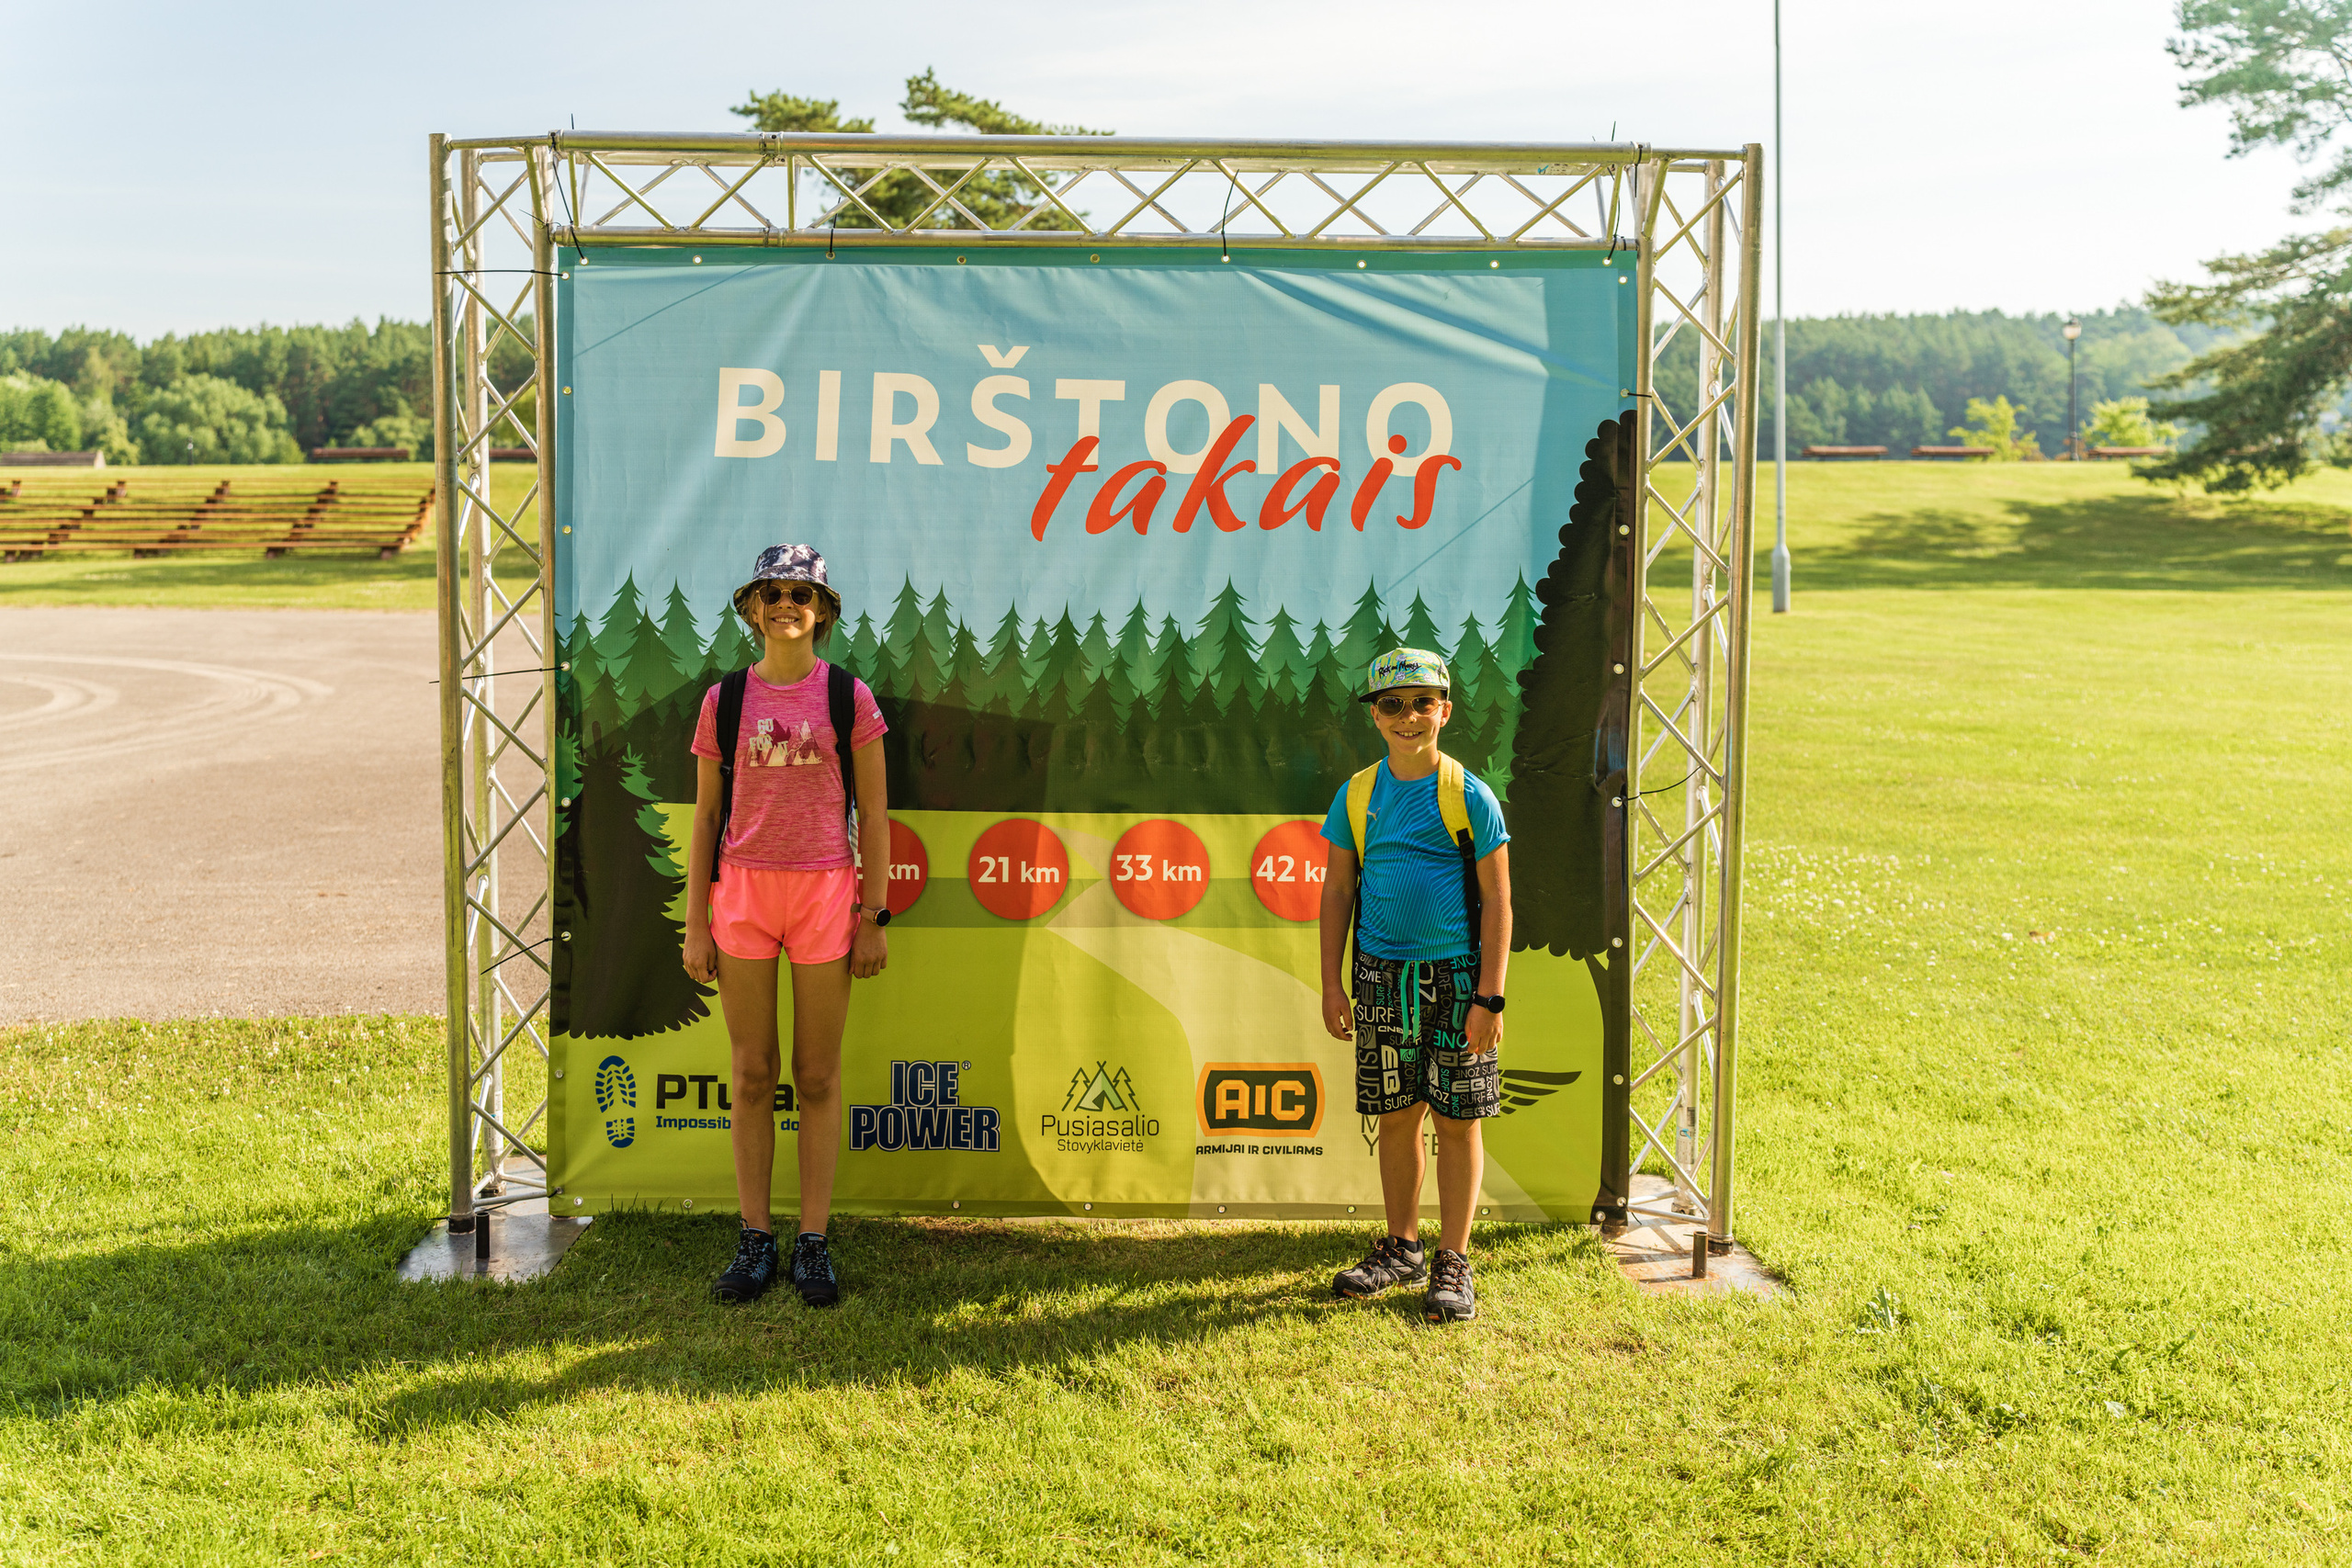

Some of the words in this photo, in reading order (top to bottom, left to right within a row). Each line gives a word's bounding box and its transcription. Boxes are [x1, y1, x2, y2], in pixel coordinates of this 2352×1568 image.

[713, 344, 1453, 477] BIRŠTONO
[1030, 413, 1463, 543] takais
[757, 718, 775, 734] GO
[749, 733, 774, 752] FOR
[978, 855, 1009, 883] 21
[1021, 861, 1060, 883] km
[1116, 854, 1153, 881] 33
[1162, 859, 1202, 882] km
[1256, 854, 1295, 882] 42
[1305, 860, 1328, 882] k
[1375, 984, 1385, 1006] SURF
[1357, 1004, 1396, 1023] SURF
[1433, 1028, 1470, 1049] ONE
[891, 1060, 960, 1108] ICE
[1357, 1049, 1382, 1112] SURF
[1404, 1062, 1417, 1093] ZONE
[1440, 1067, 1450, 1092] SURF
[1454, 1066, 1480, 1079] ZONE
[1459, 1090, 1486, 1105] SURF
[1486, 1075, 1495, 1101] ZONE
[1215, 1079, 1306, 1122] AIC
[1384, 1093, 1415, 1111] SURF
[1452, 1094, 1460, 1117] ZONE
[655, 1115, 775, 1131] Impossib
[849, 1105, 1001, 1153] POWER
[1041, 1114, 1160, 1137] Pusiasalio
[1057, 1138, 1145, 1155] Stovyklavietė
[1195, 1144, 1245, 1156] ARMIJAI
[1248, 1145, 1260, 1155] IR
[1262, 1145, 1324, 1156] CIVILIAMS
